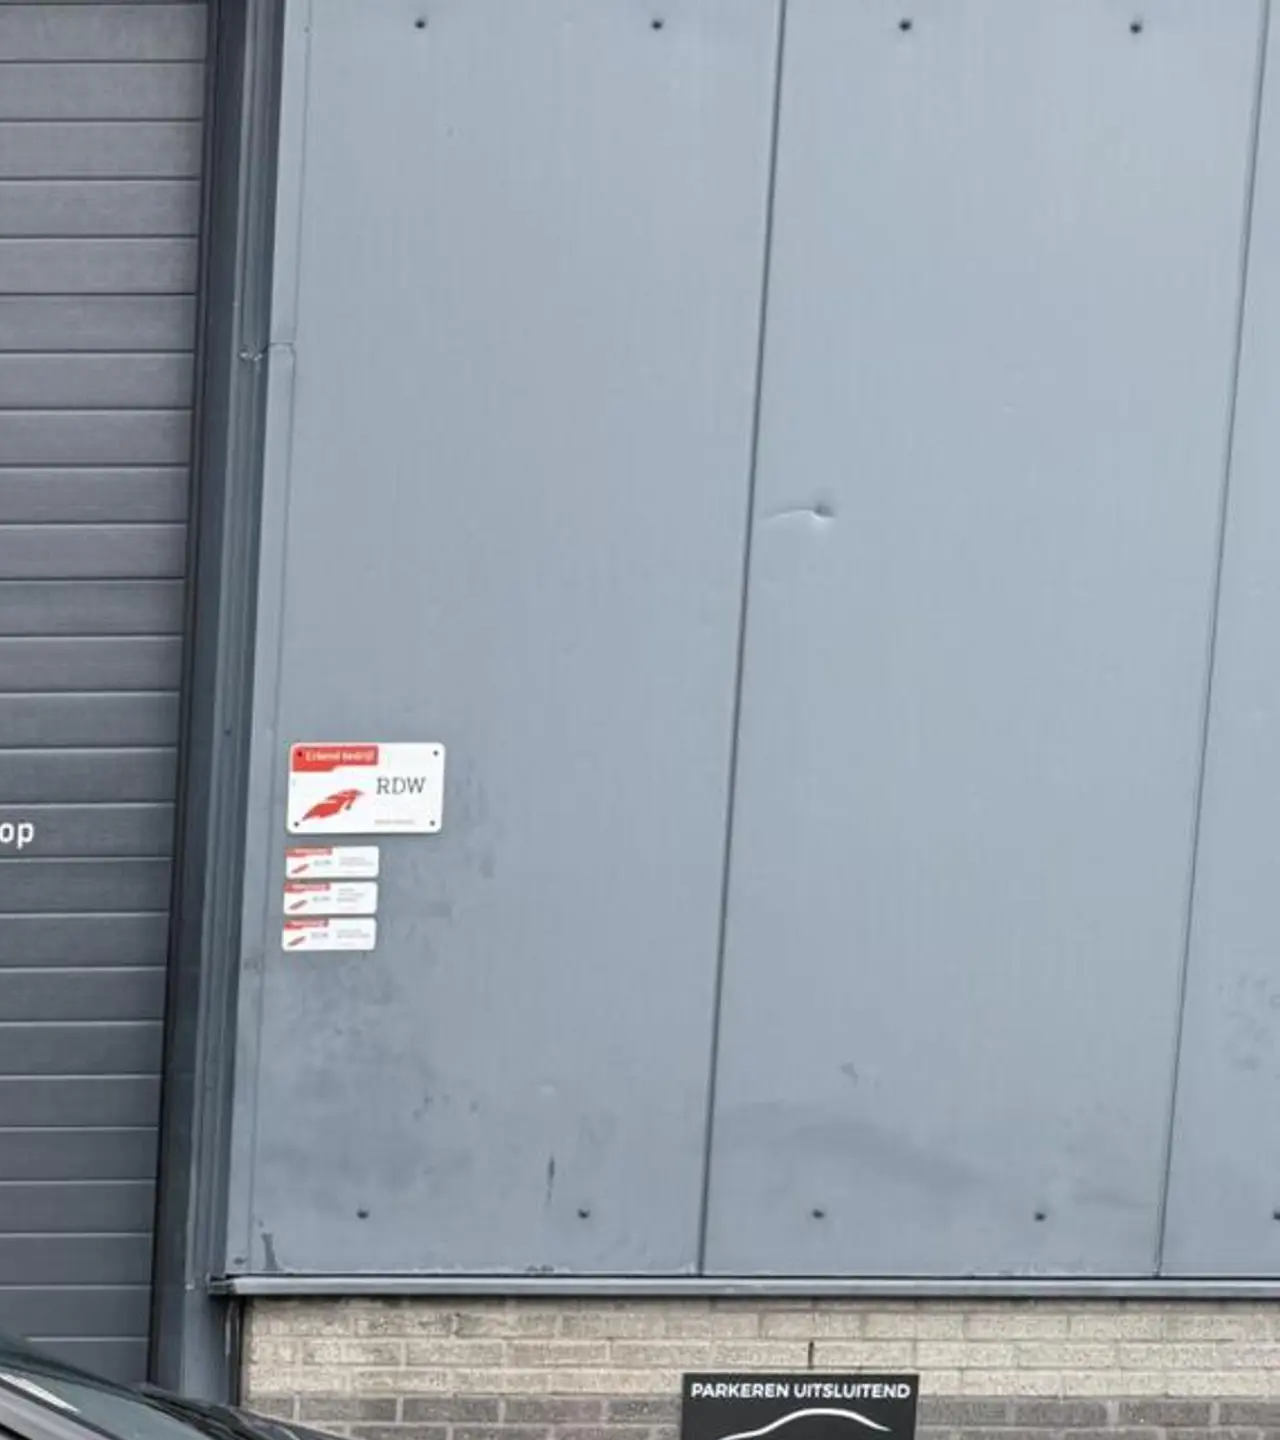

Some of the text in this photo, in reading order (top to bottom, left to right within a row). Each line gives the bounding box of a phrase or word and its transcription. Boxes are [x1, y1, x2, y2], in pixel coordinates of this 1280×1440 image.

[376, 776, 427, 796] RDW
[690, 1382, 912, 1400] PARKEREN UITSLUITEND
